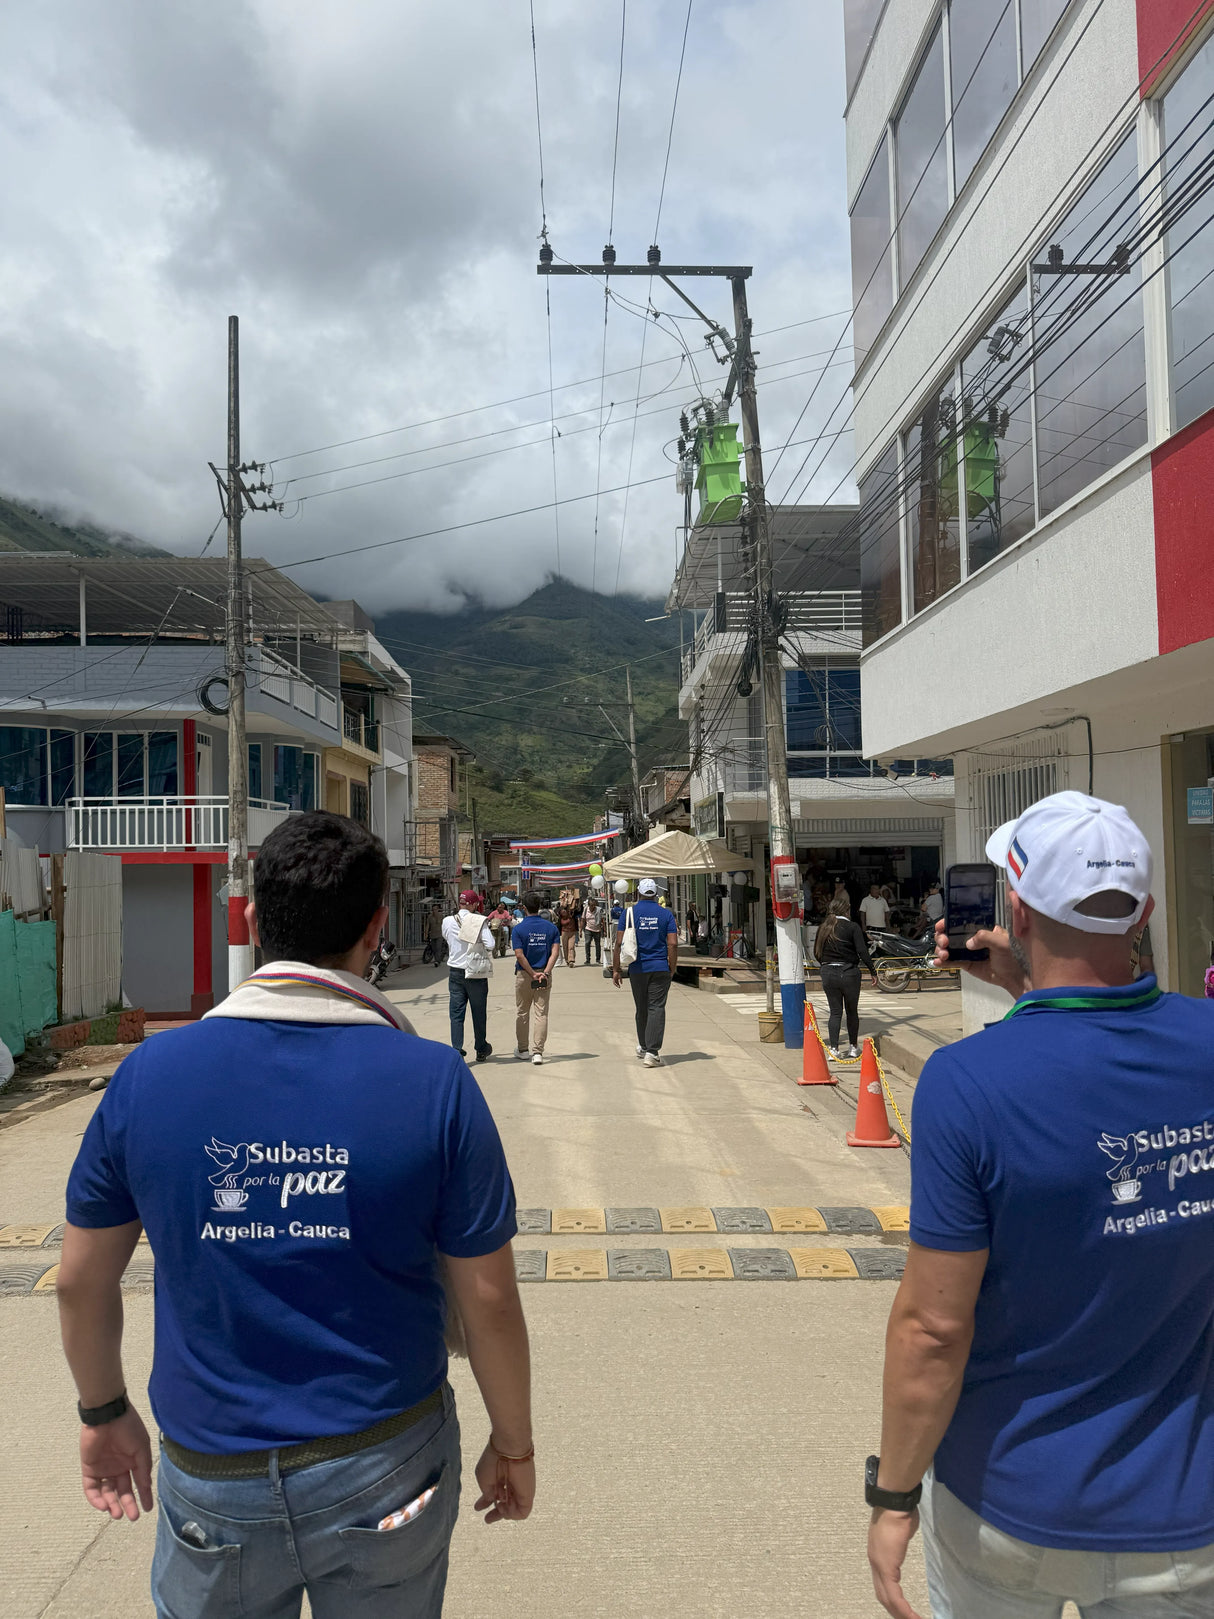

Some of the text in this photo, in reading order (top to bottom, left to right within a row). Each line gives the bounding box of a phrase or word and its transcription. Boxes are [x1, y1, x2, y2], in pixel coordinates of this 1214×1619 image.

[1135, 1120, 1214, 1153] Subast
[249, 1140, 349, 1165] Subasta
[1136, 1163, 1155, 1180] por
[1156, 1159, 1167, 1171] la
[243, 1169, 346, 1208] por la paz
[200, 1221, 275, 1243] Argelia
[288, 1220, 350, 1240] Cauca
[1103, 1207, 1168, 1235] Argelia
[1177, 1199, 1214, 1218] Cau
